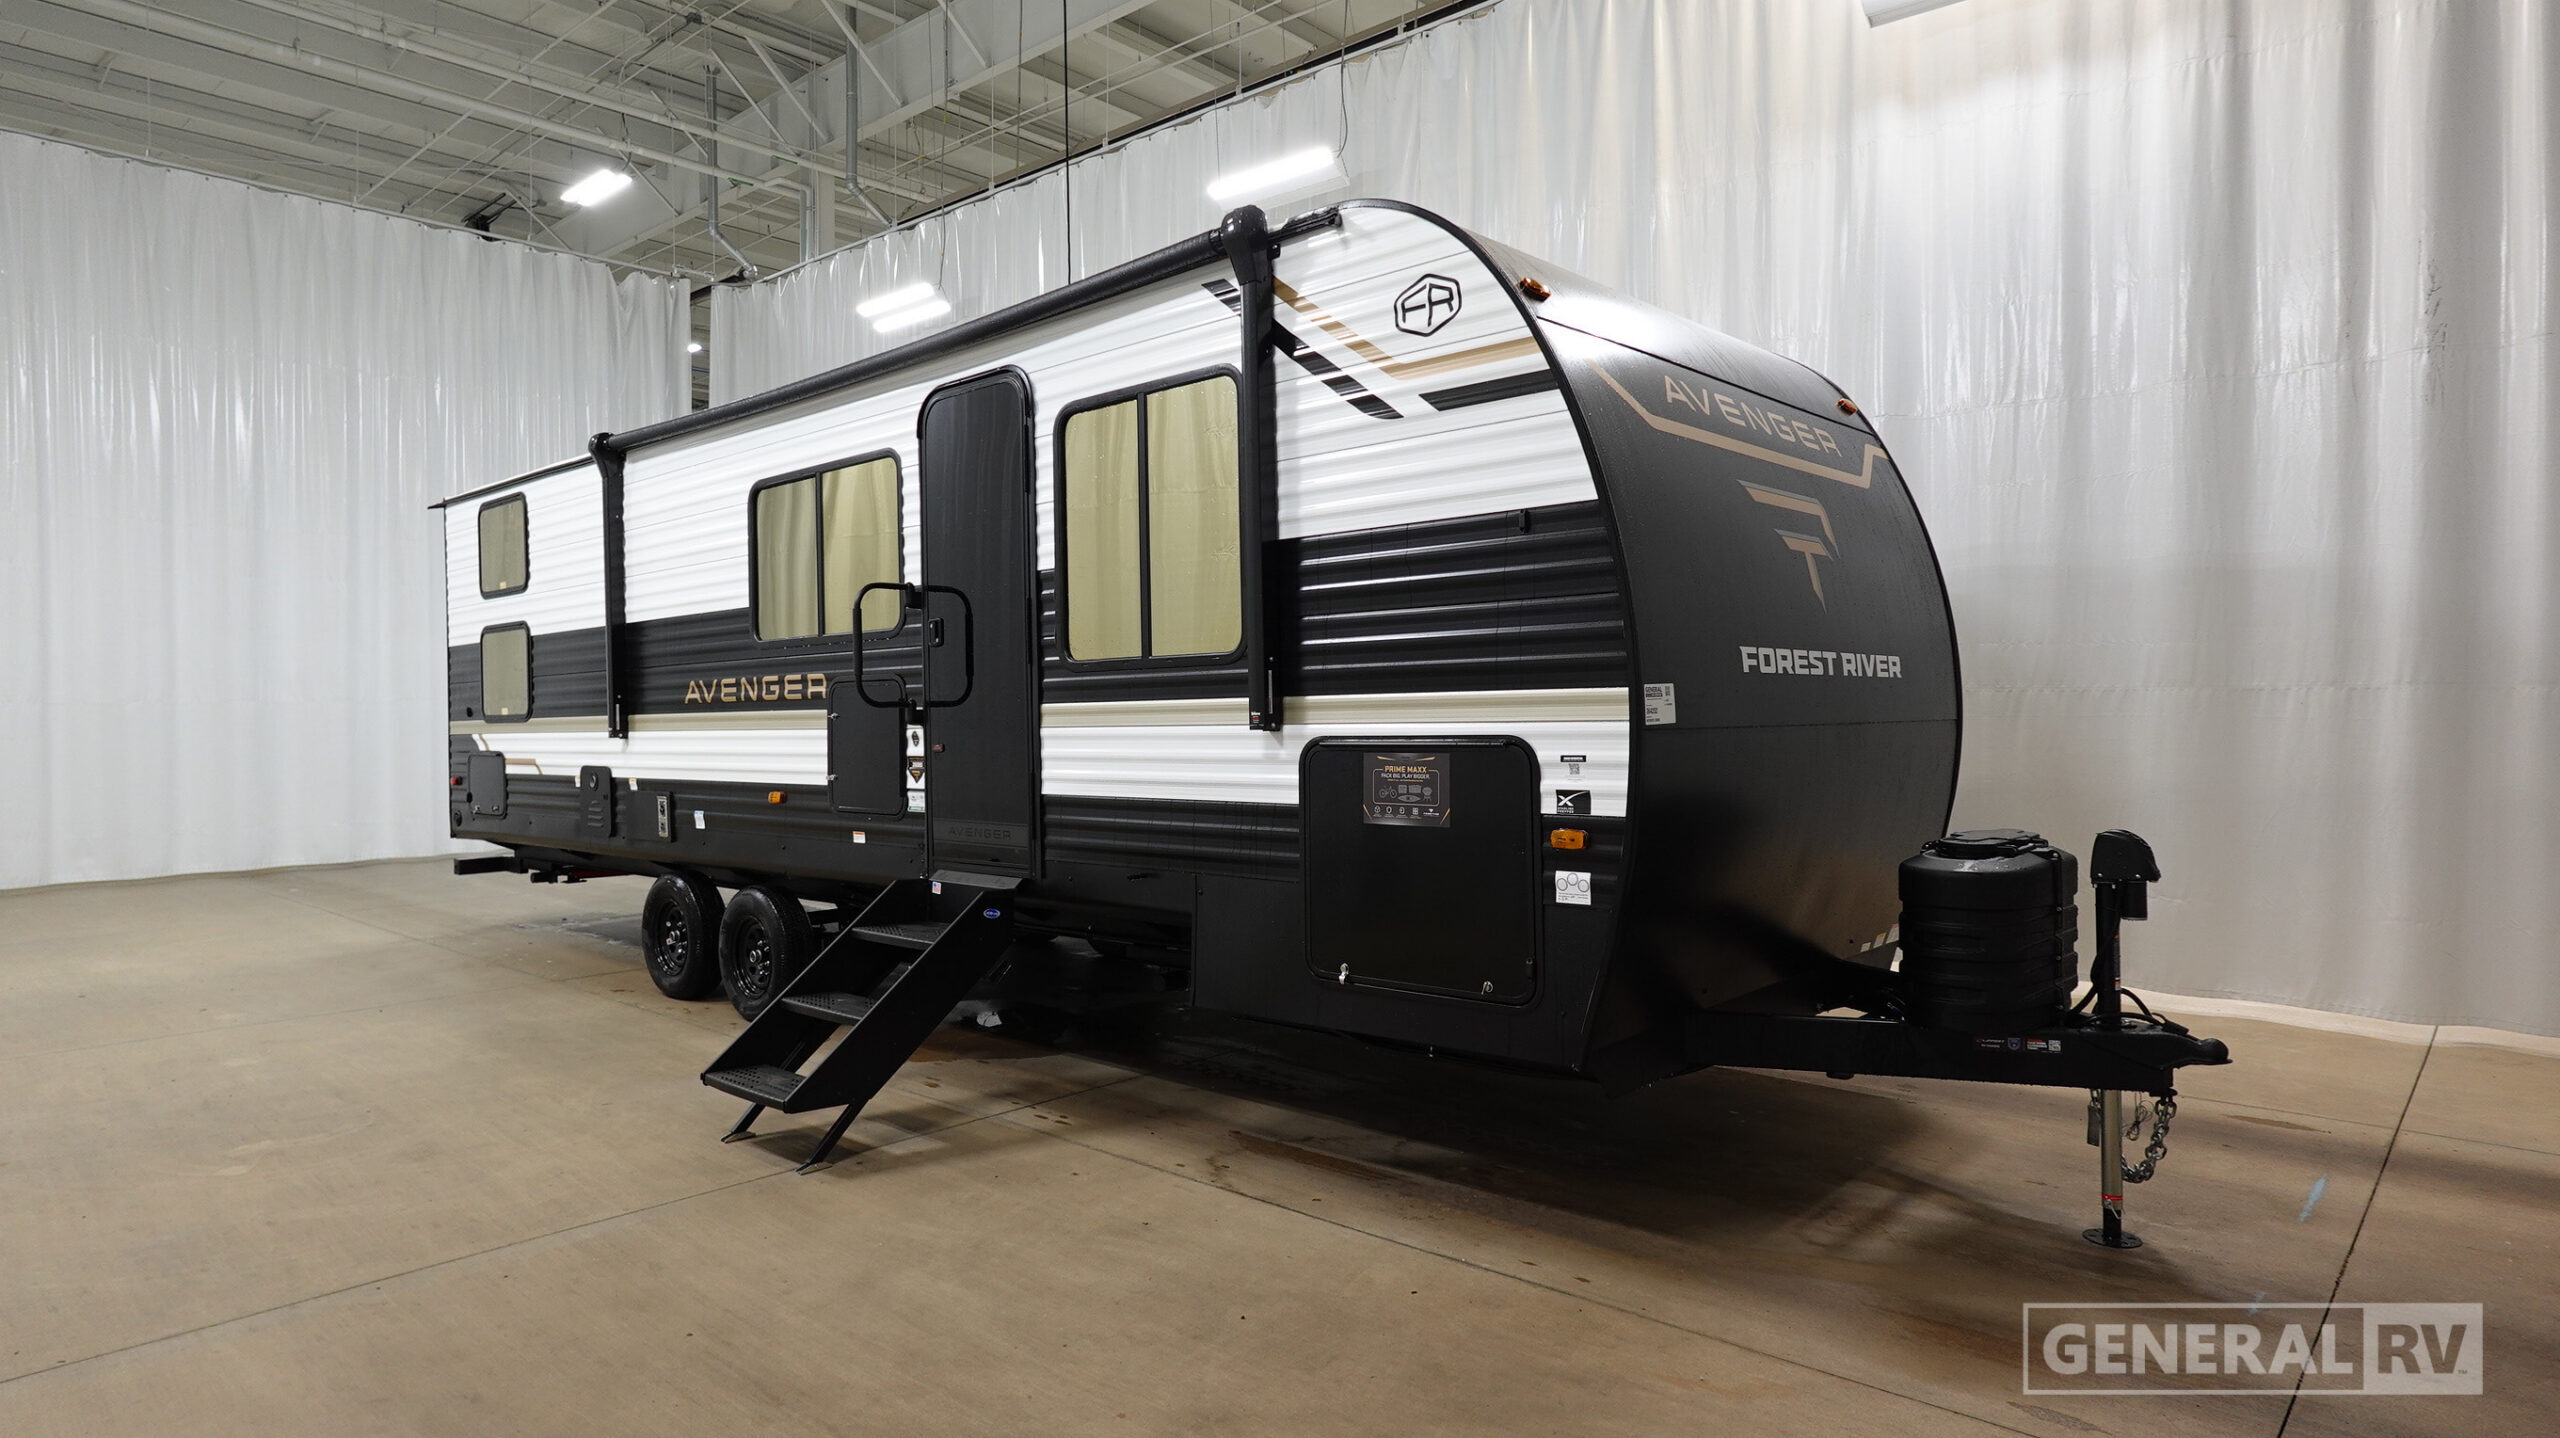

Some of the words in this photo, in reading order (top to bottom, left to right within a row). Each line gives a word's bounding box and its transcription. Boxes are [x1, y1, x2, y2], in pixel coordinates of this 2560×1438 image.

[1663, 374, 1843, 457] AVENGER
[1739, 645, 1837, 677] FOREST
[1840, 651, 1902, 679] RIVER
[684, 672, 828, 705] AVENGER
[1384, 765, 1406, 773] PRIME
[1407, 766, 1428, 774] MAXX
[949, 826, 1012, 841] AVENGER
